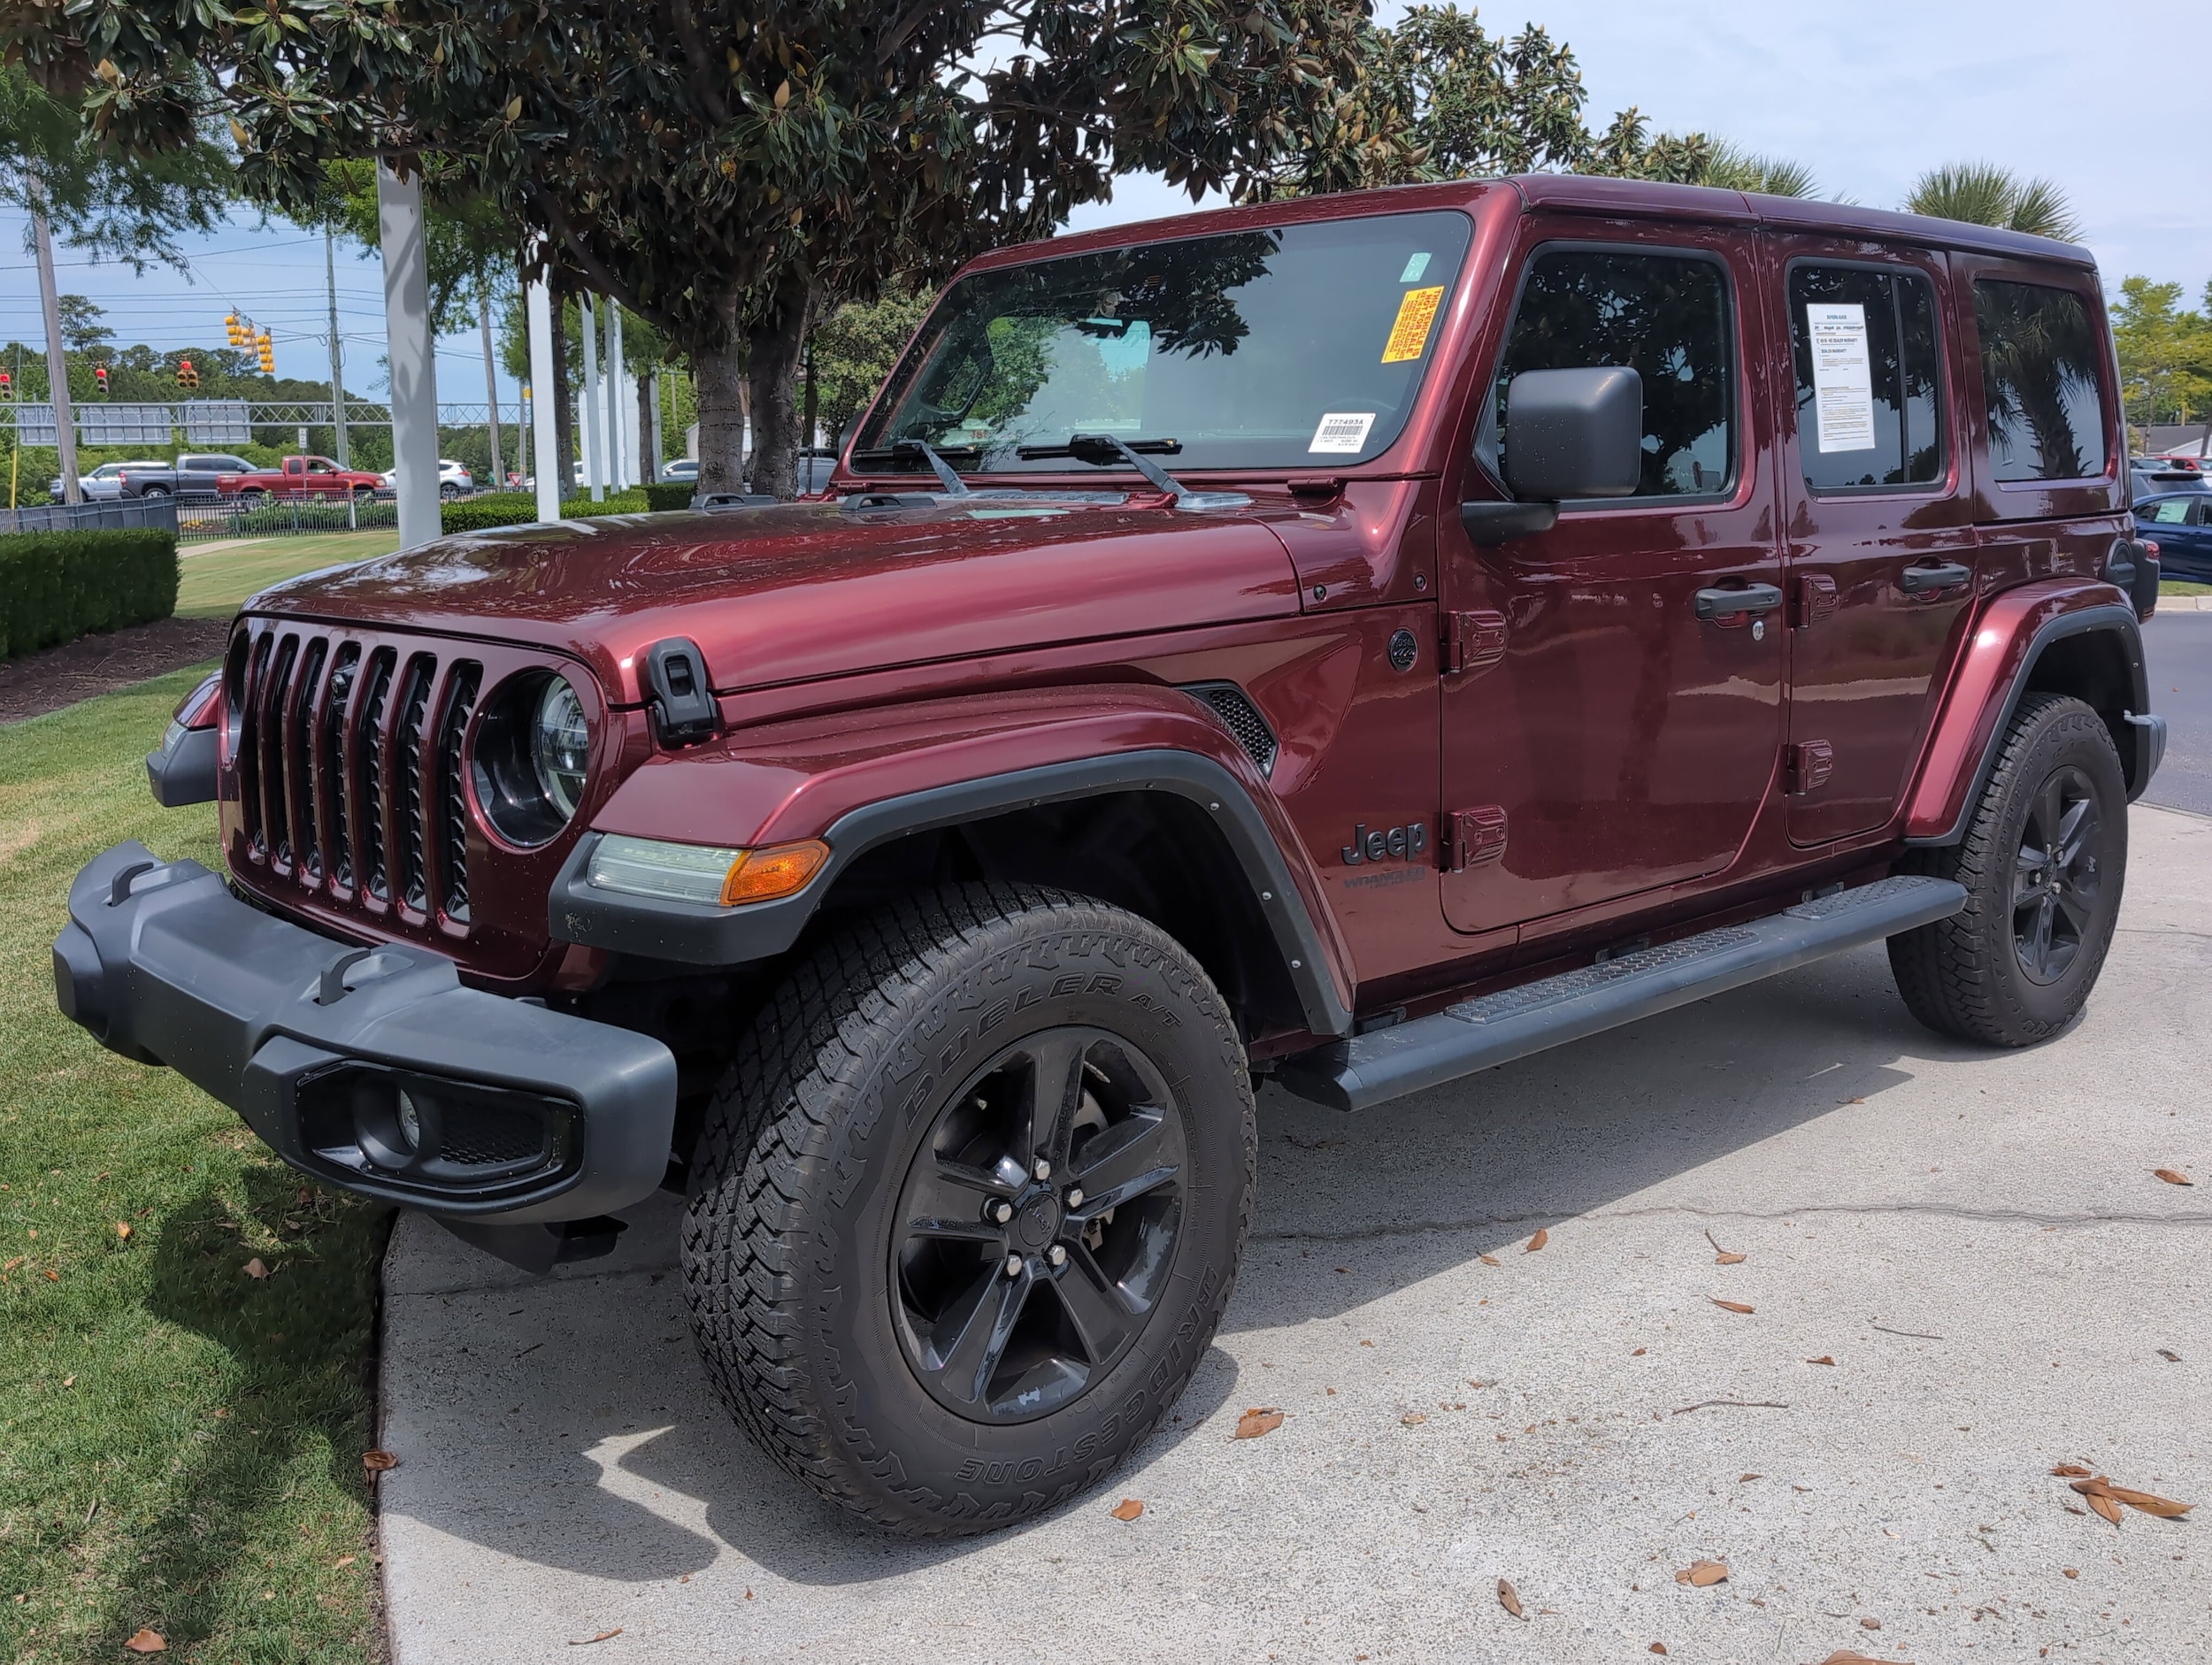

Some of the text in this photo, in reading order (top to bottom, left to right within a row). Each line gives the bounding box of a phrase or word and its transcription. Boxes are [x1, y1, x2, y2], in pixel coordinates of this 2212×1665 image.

[1411, 288, 1441, 357] THIS VEHICLE IS
[1415, 312, 1425, 330] FOR
[1421, 294, 1432, 311] NOT
[1406, 332, 1419, 354] SALE
[1341, 822, 1428, 866] Jeep
[899, 971, 1183, 1132] DUELER A/T
[953, 1261, 1219, 1485] BRIDGESTONE
